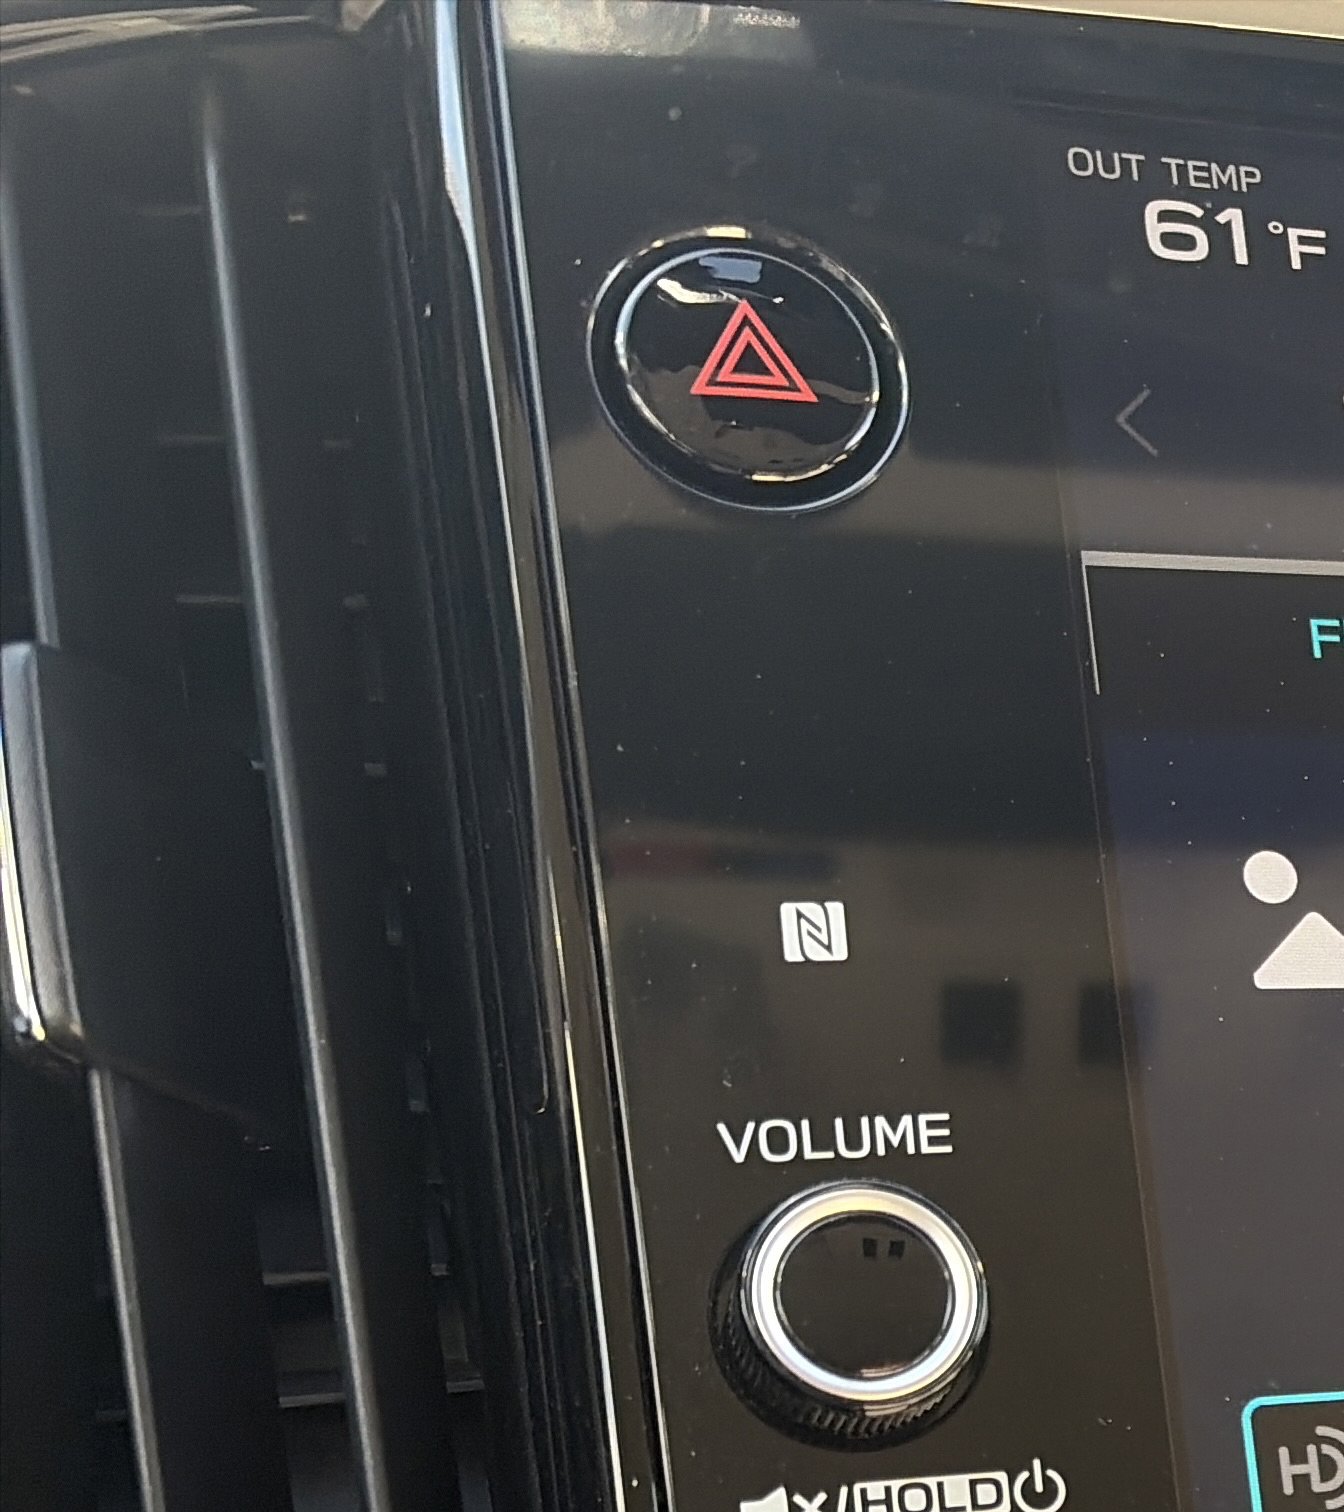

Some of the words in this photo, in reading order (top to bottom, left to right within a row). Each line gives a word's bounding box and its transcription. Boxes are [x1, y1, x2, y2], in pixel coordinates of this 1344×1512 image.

[1066, 146, 1146, 183] OUT
[1161, 157, 1262, 193] TEMP
[716, 1112, 953, 1164] VOLUME
